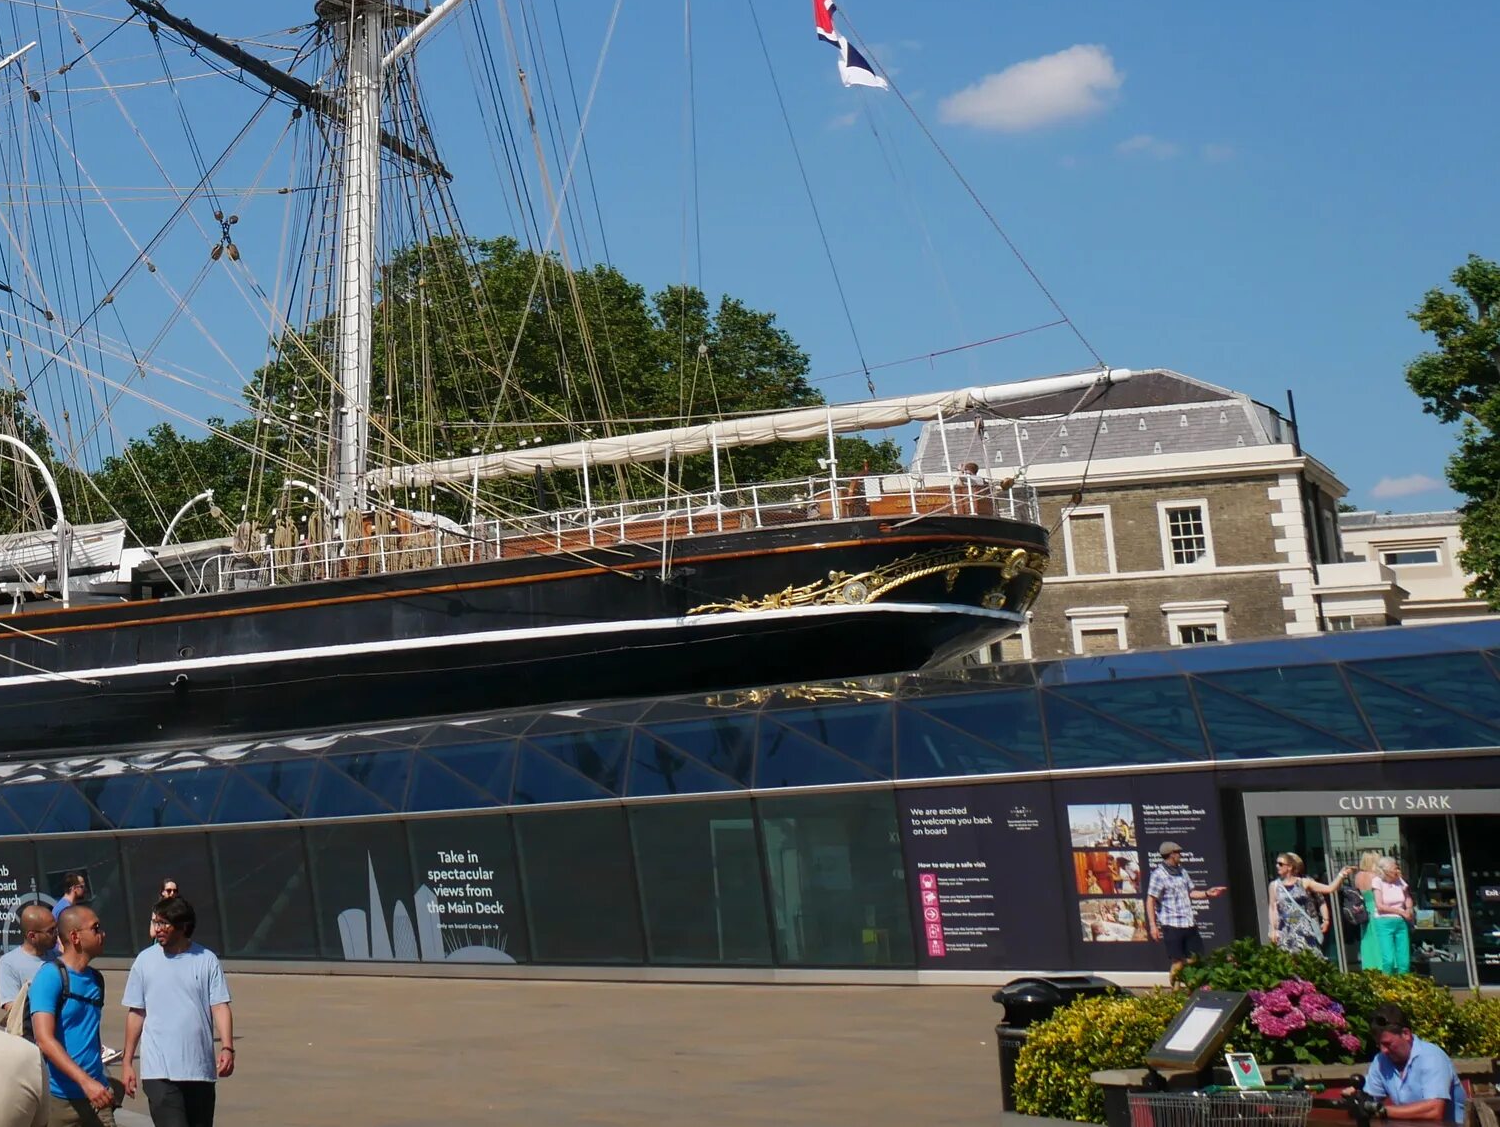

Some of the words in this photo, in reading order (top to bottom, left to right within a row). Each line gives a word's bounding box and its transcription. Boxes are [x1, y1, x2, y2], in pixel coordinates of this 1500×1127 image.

[1339, 796, 1398, 810] CUTTY
[1405, 795, 1452, 810] SARK
[910, 807, 924, 816] We
[925, 808, 938, 816] are
[939, 806, 968, 816] excited
[911, 817, 921, 826] to
[922, 817, 956, 826] welcome
[957, 818, 972, 826] you
[973, 816, 993, 825] back
[912, 828, 924, 836] on
[924, 827, 948, 836] board
[437, 850, 465, 863] Take
[467, 849, 479, 863] in
[939, 861, 956, 869] enjoy
[427, 866, 494, 882] spectacular
[433, 883, 464, 897] views
[465, 883, 493, 897] from
[1485, 888, 1499, 896] Exit
[426, 900, 446, 914] the
[447, 900, 474, 914] Main
[475, 900, 504, 914] Deck
